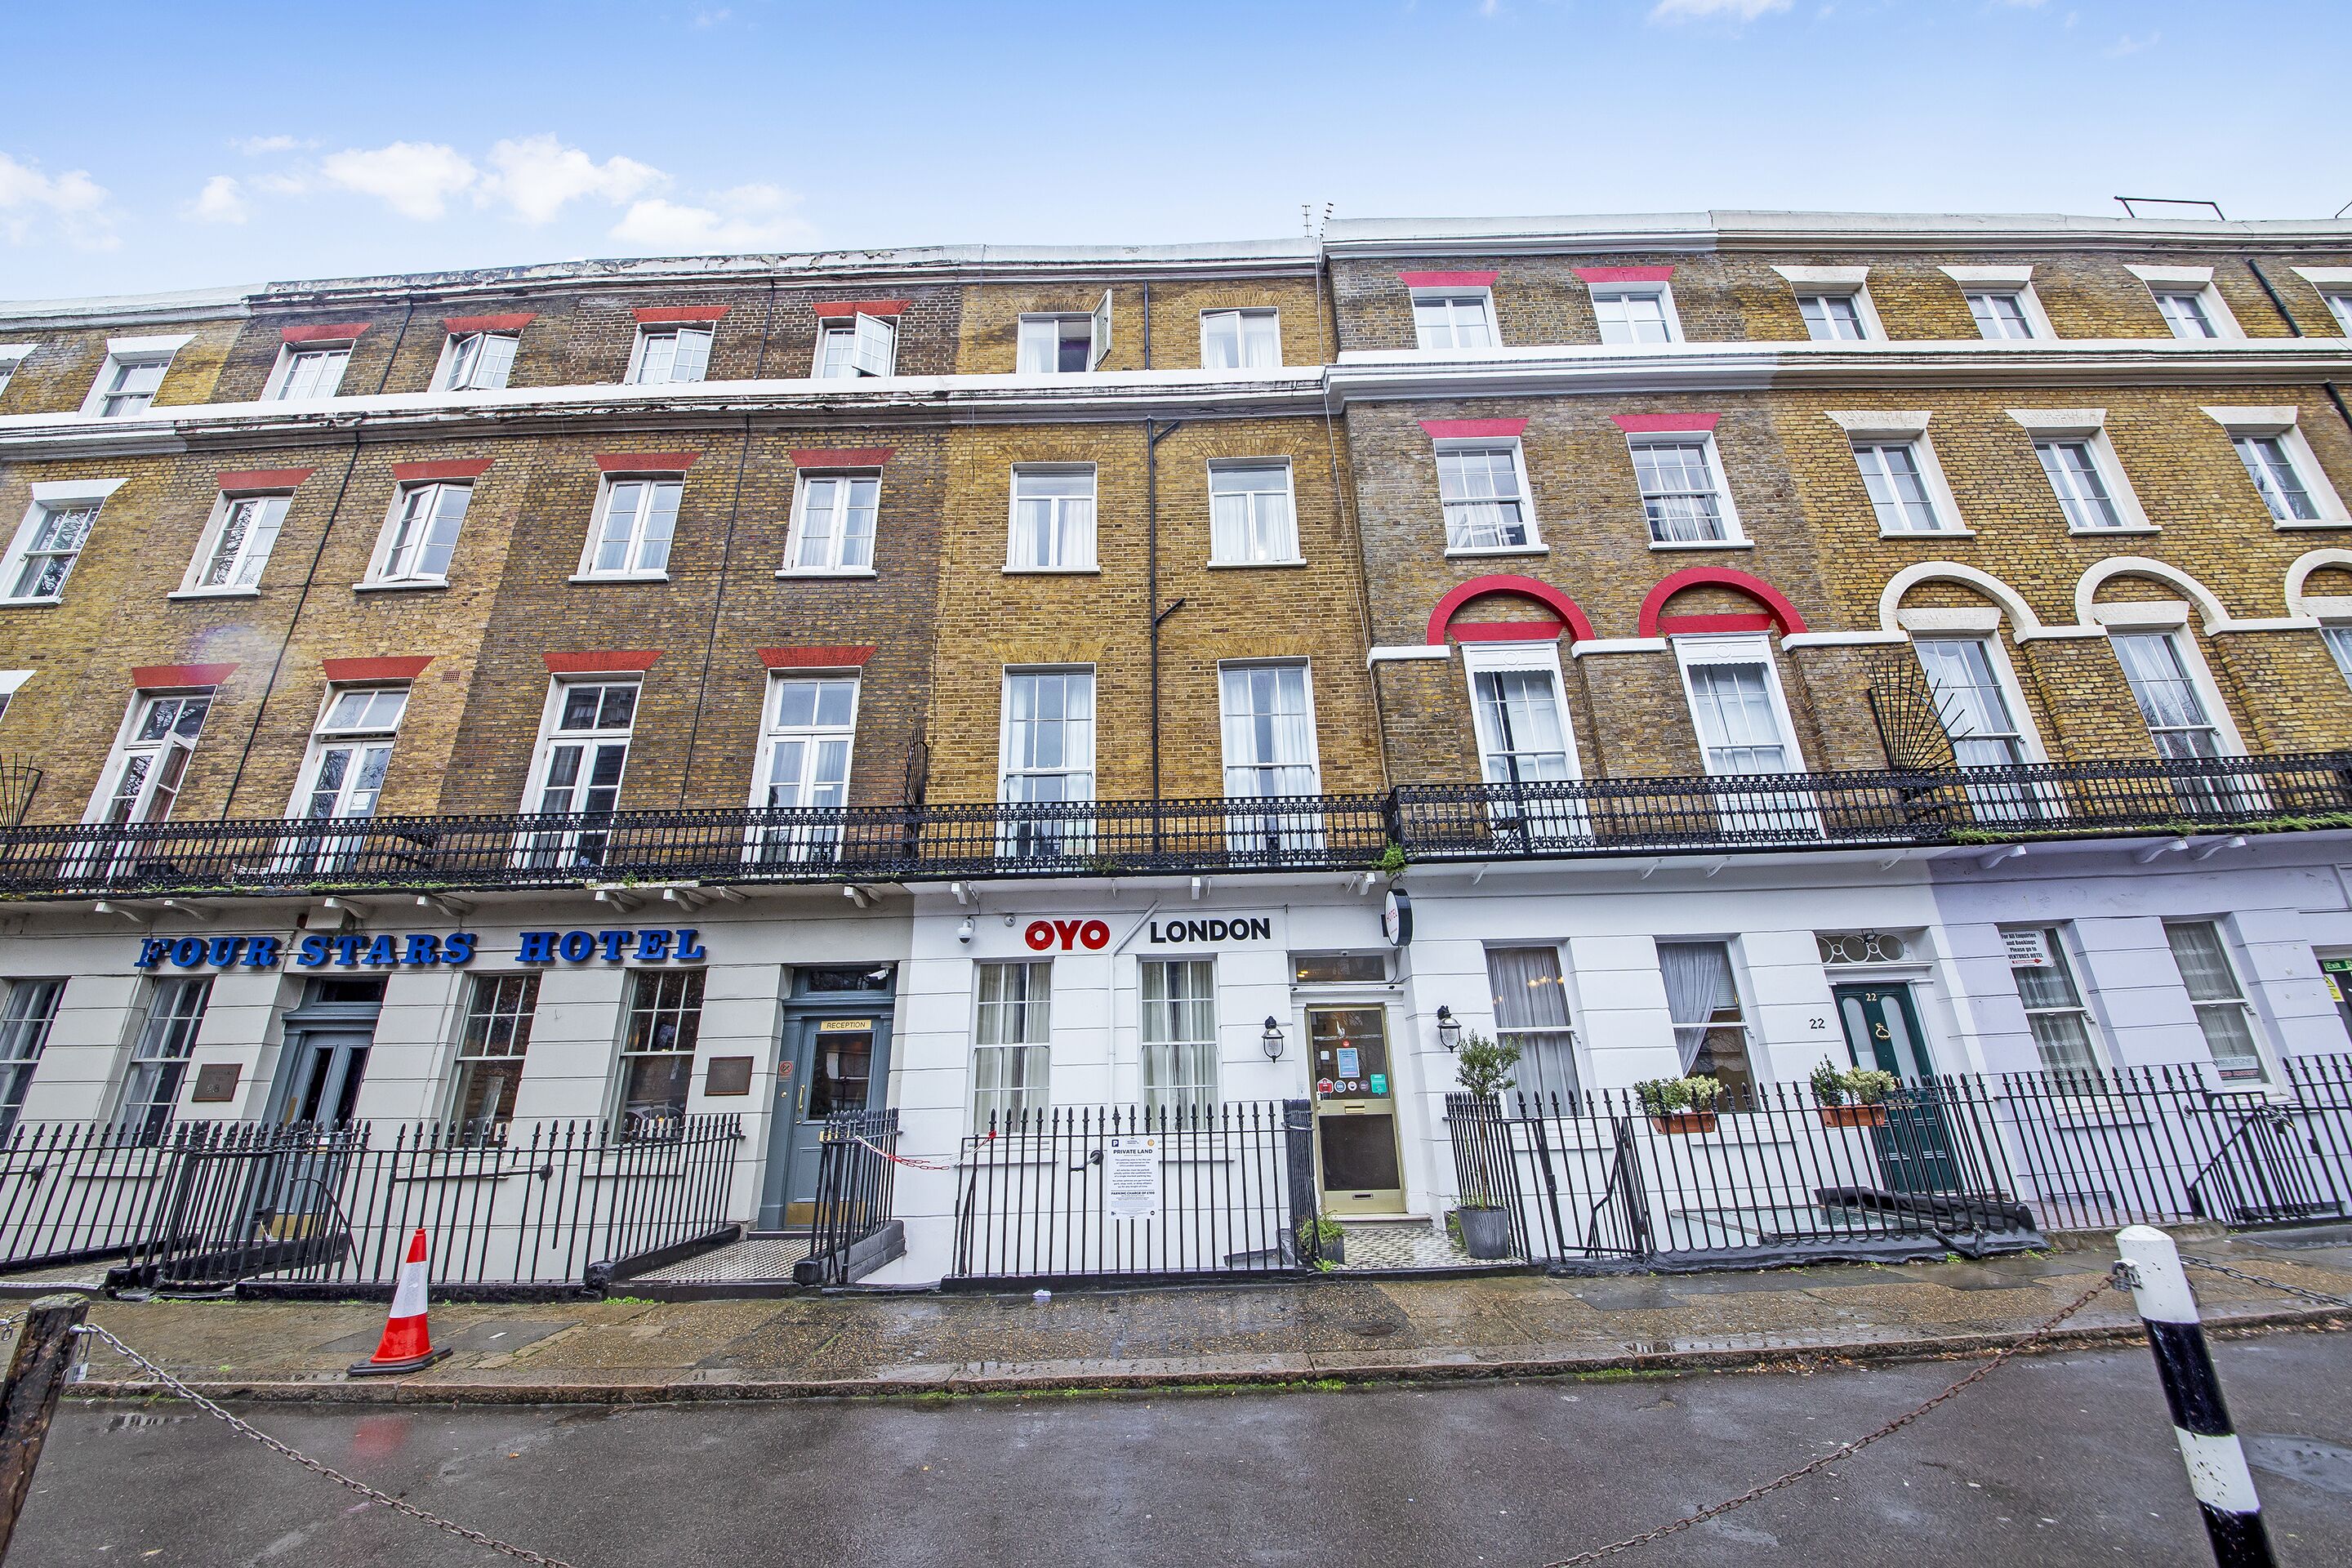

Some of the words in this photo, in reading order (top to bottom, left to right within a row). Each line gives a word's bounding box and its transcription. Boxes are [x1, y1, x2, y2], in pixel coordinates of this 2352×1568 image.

[1025, 920, 1111, 951] OYO
[1150, 918, 1271, 943] LONDON
[134, 937, 283, 968] FOUR
[296, 933, 479, 966] STARS
[514, 929, 706, 963] HOTEL
[1865, 993, 1877, 1001] 22
[1809, 1018, 1825, 1029] 22
